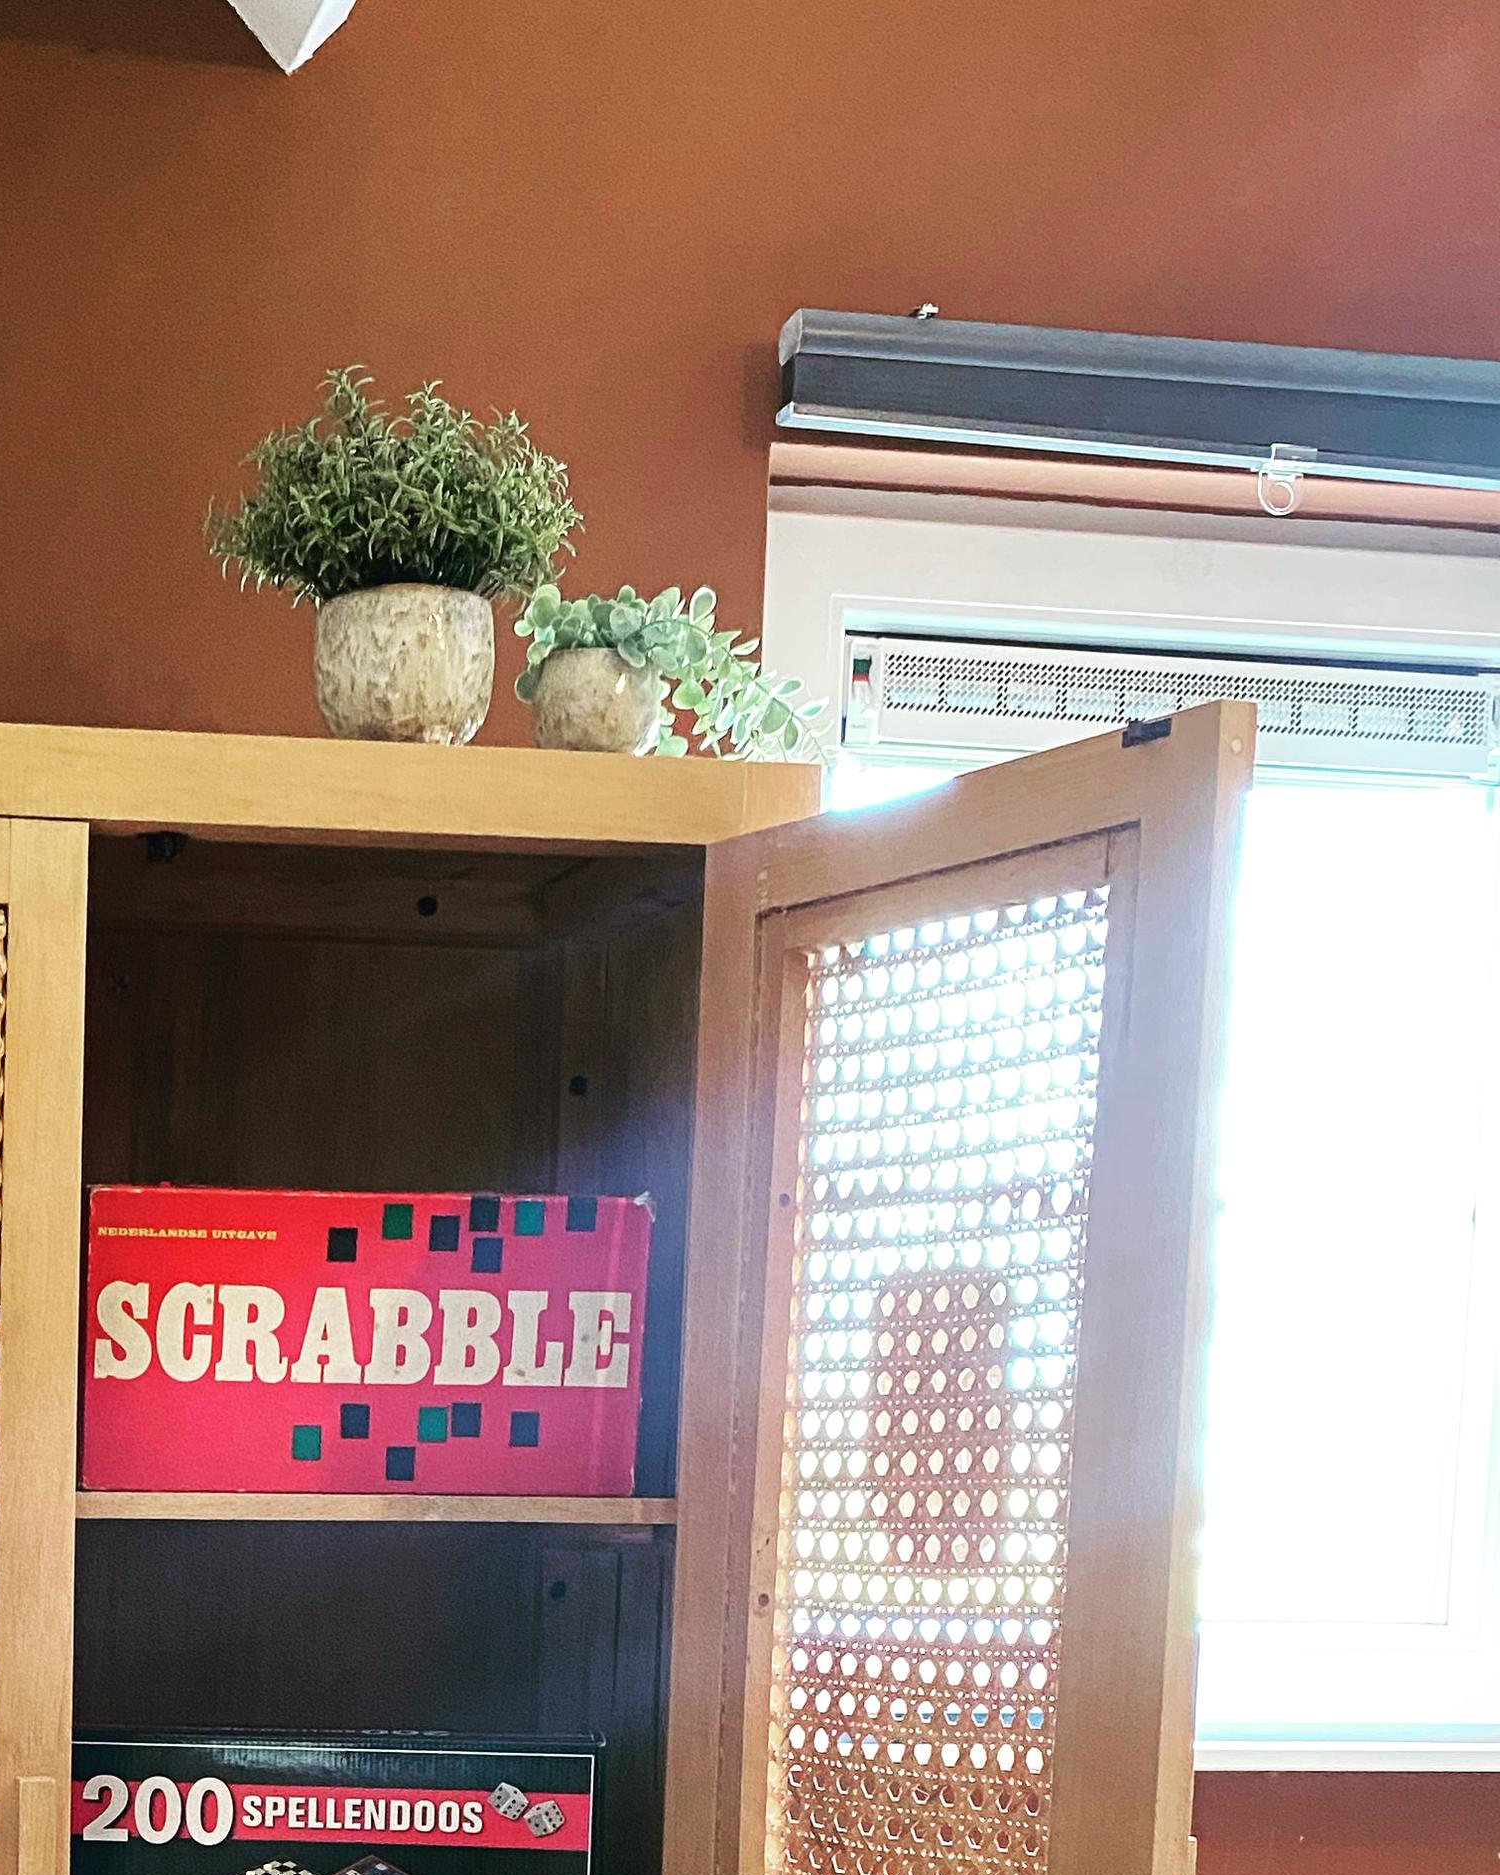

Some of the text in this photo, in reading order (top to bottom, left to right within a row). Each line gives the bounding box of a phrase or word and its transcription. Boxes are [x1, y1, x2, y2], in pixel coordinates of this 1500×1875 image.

[97, 1226, 277, 1240] NEDERLANDSE UITGAVE
[93, 1280, 632, 1388] SCRABBLE
[82, 1774, 484, 1846] 200 SPELLENDOOS
